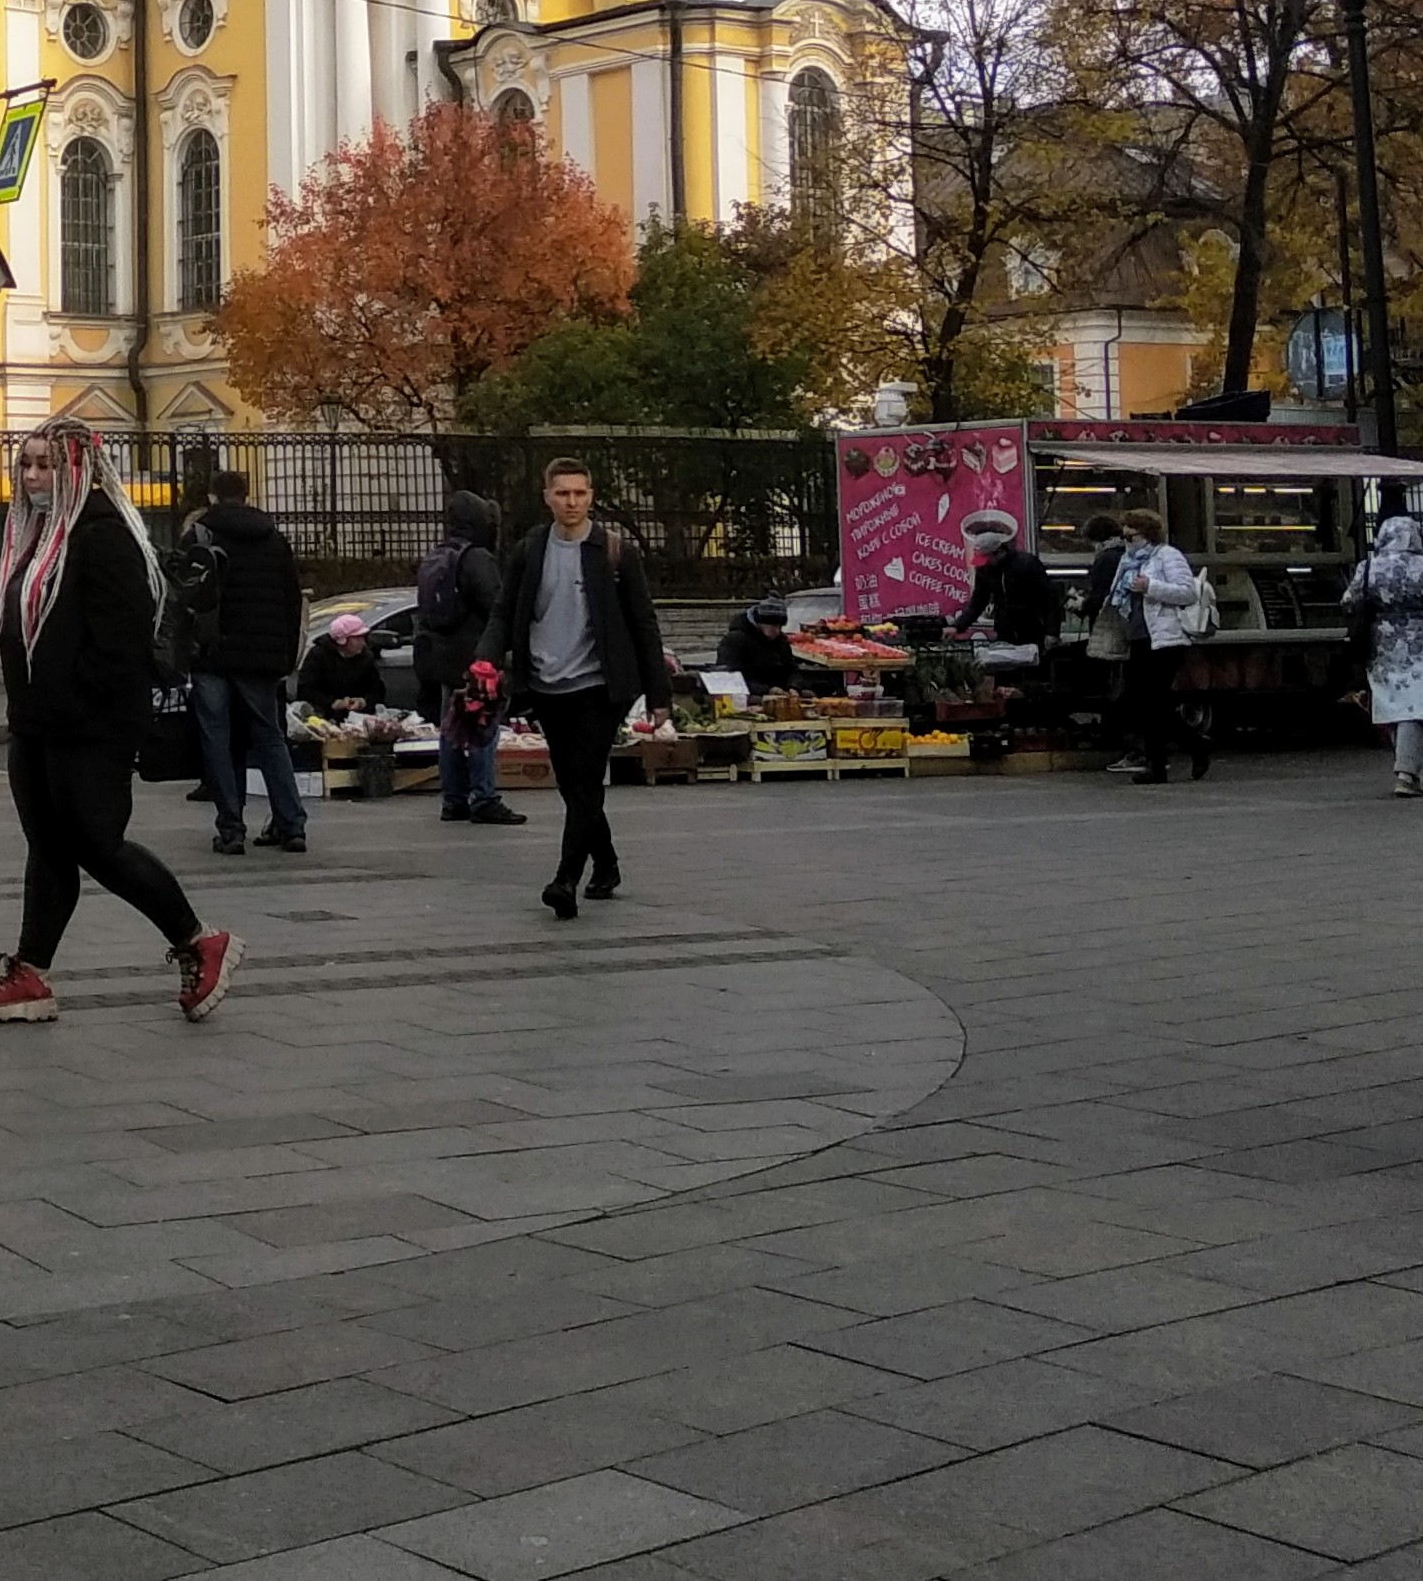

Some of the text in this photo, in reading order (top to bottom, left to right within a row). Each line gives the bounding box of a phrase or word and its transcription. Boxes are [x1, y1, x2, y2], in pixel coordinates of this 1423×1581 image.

[857, 536, 882, 560] КОФЕ
[889, 511, 921, 540] СОБОЙ
[915, 532, 966, 561] ICE CREAM
[912, 550, 943, 572] CAKES
[909, 570, 968, 604] COFFEE TAKE
